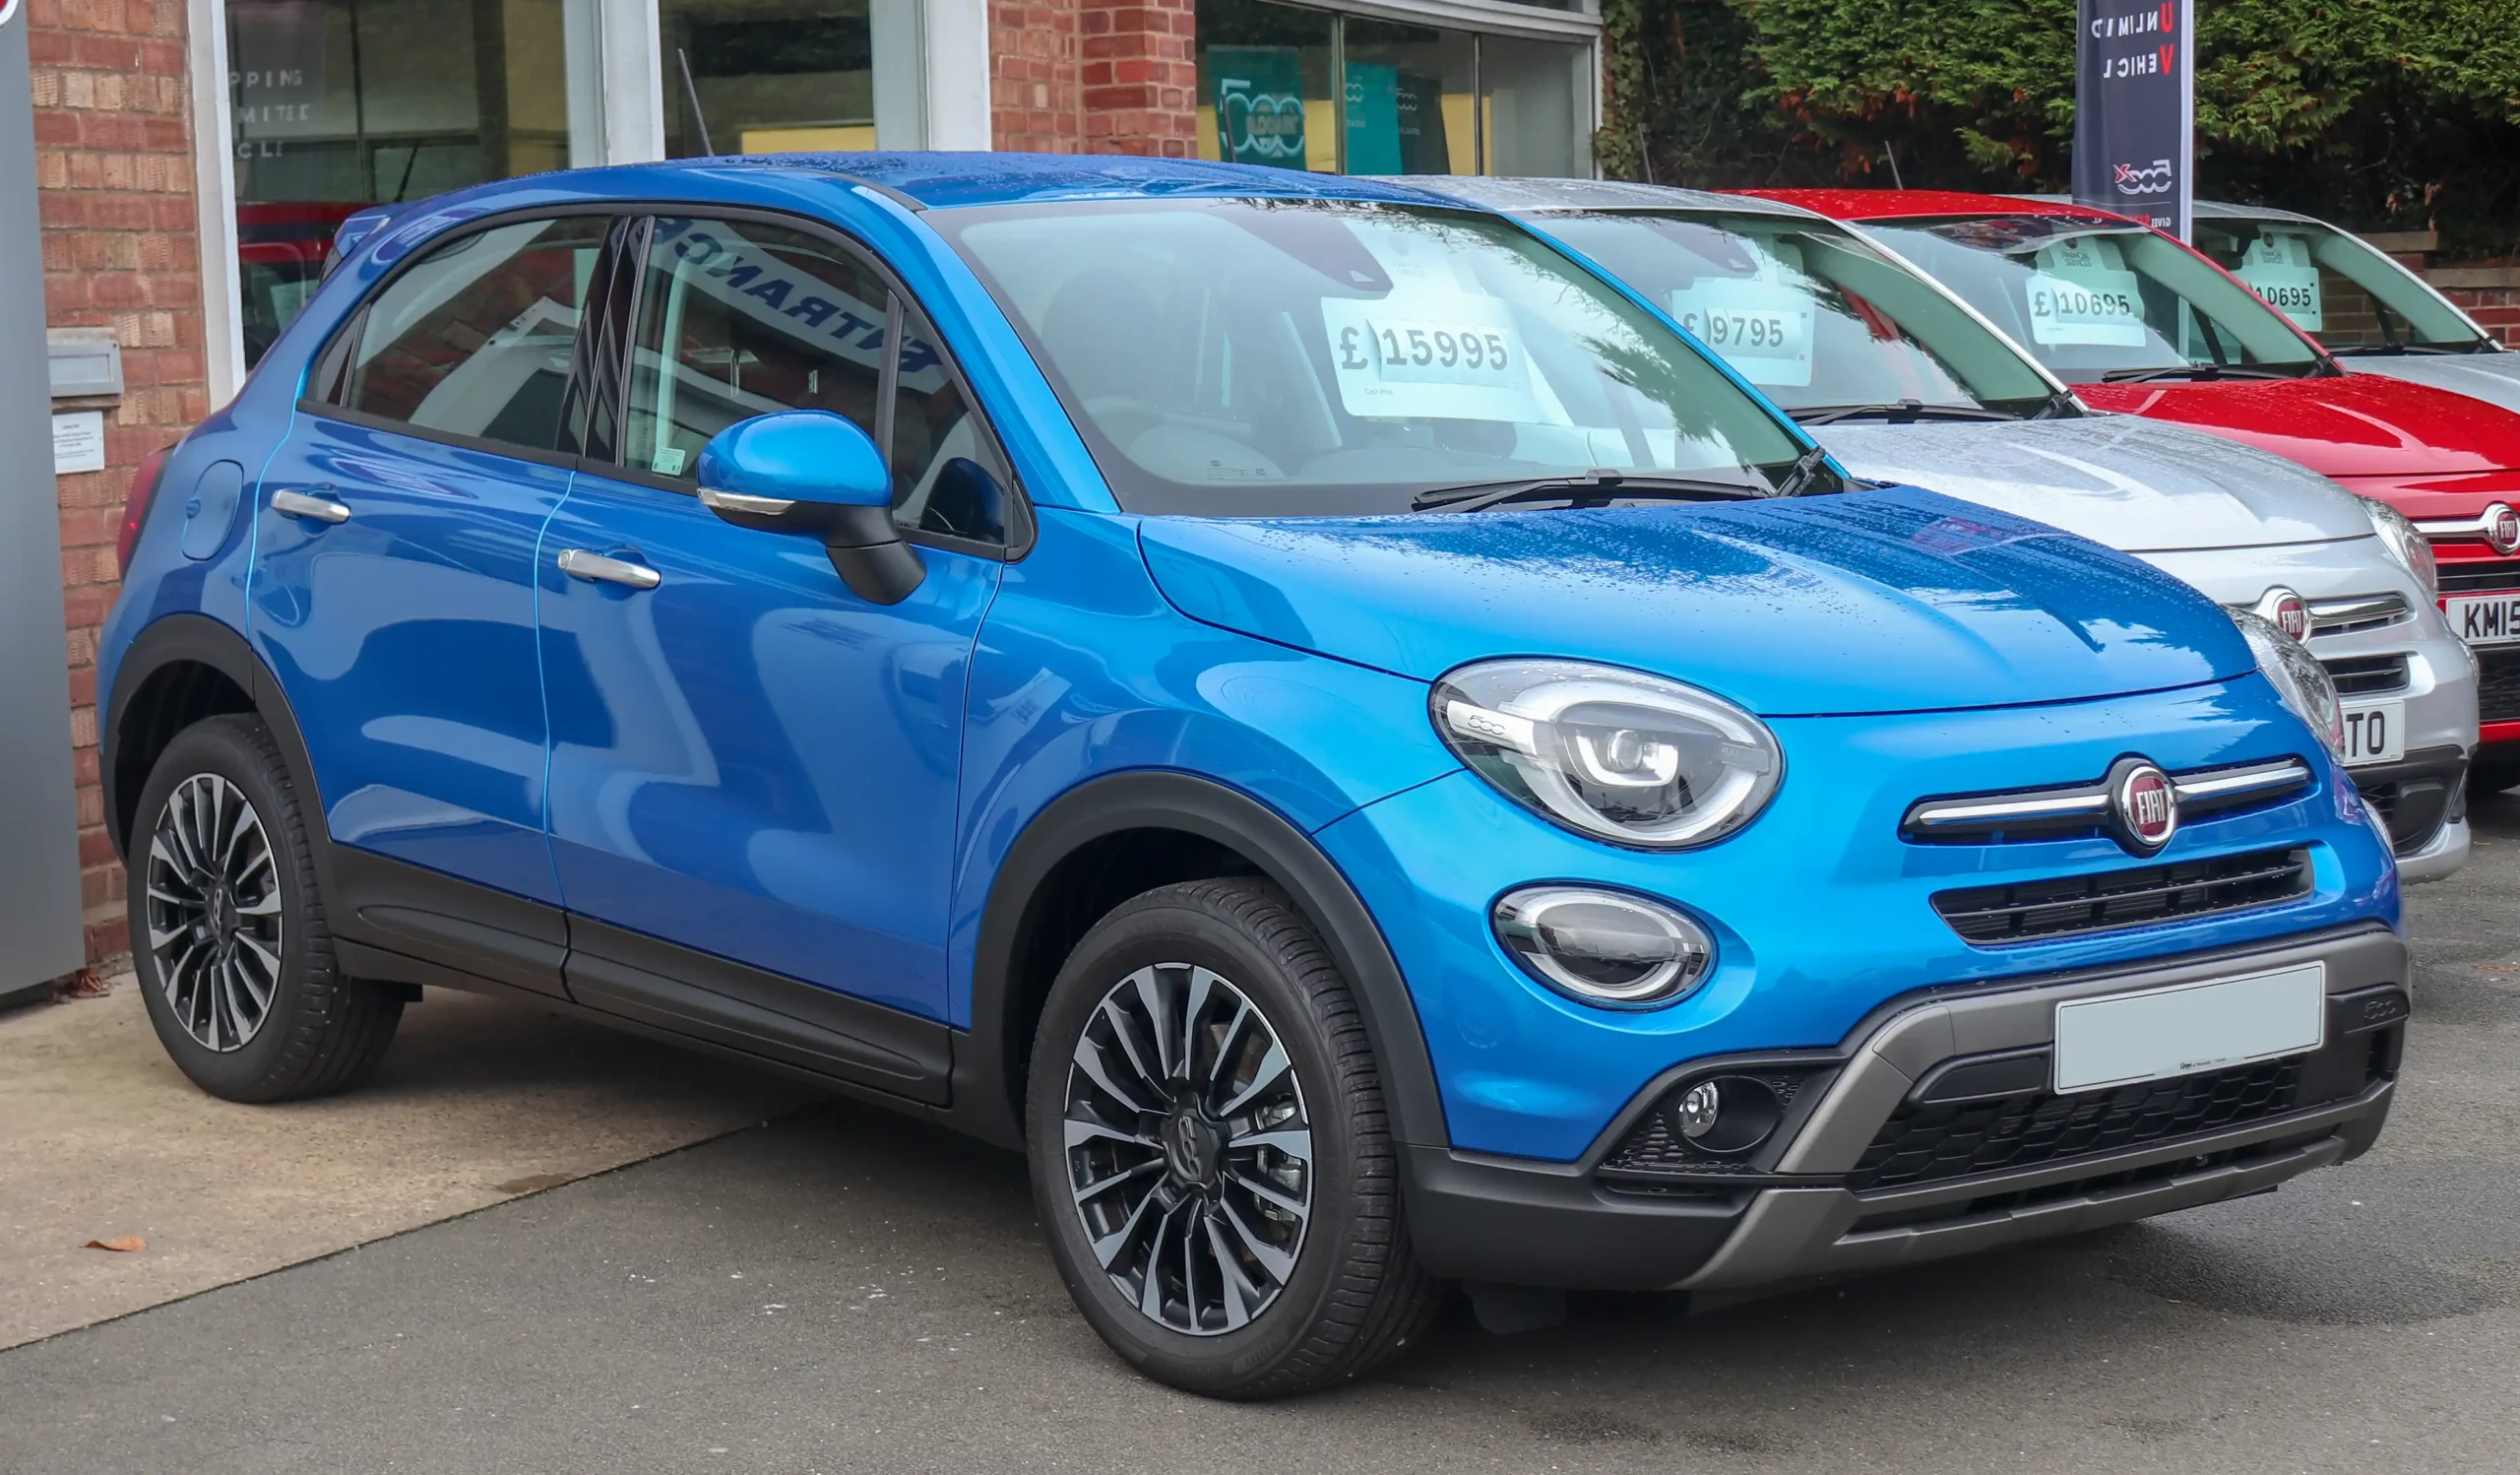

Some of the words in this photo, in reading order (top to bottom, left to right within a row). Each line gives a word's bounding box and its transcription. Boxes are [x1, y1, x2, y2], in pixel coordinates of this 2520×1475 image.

[2499, 520, 2516, 539] FIAT
[2281, 609, 2303, 634] FIAT
[2464, 601, 2520, 639] KM15
[1468, 715, 1506, 736] 500
[2135, 788, 2167, 825] FIAT
